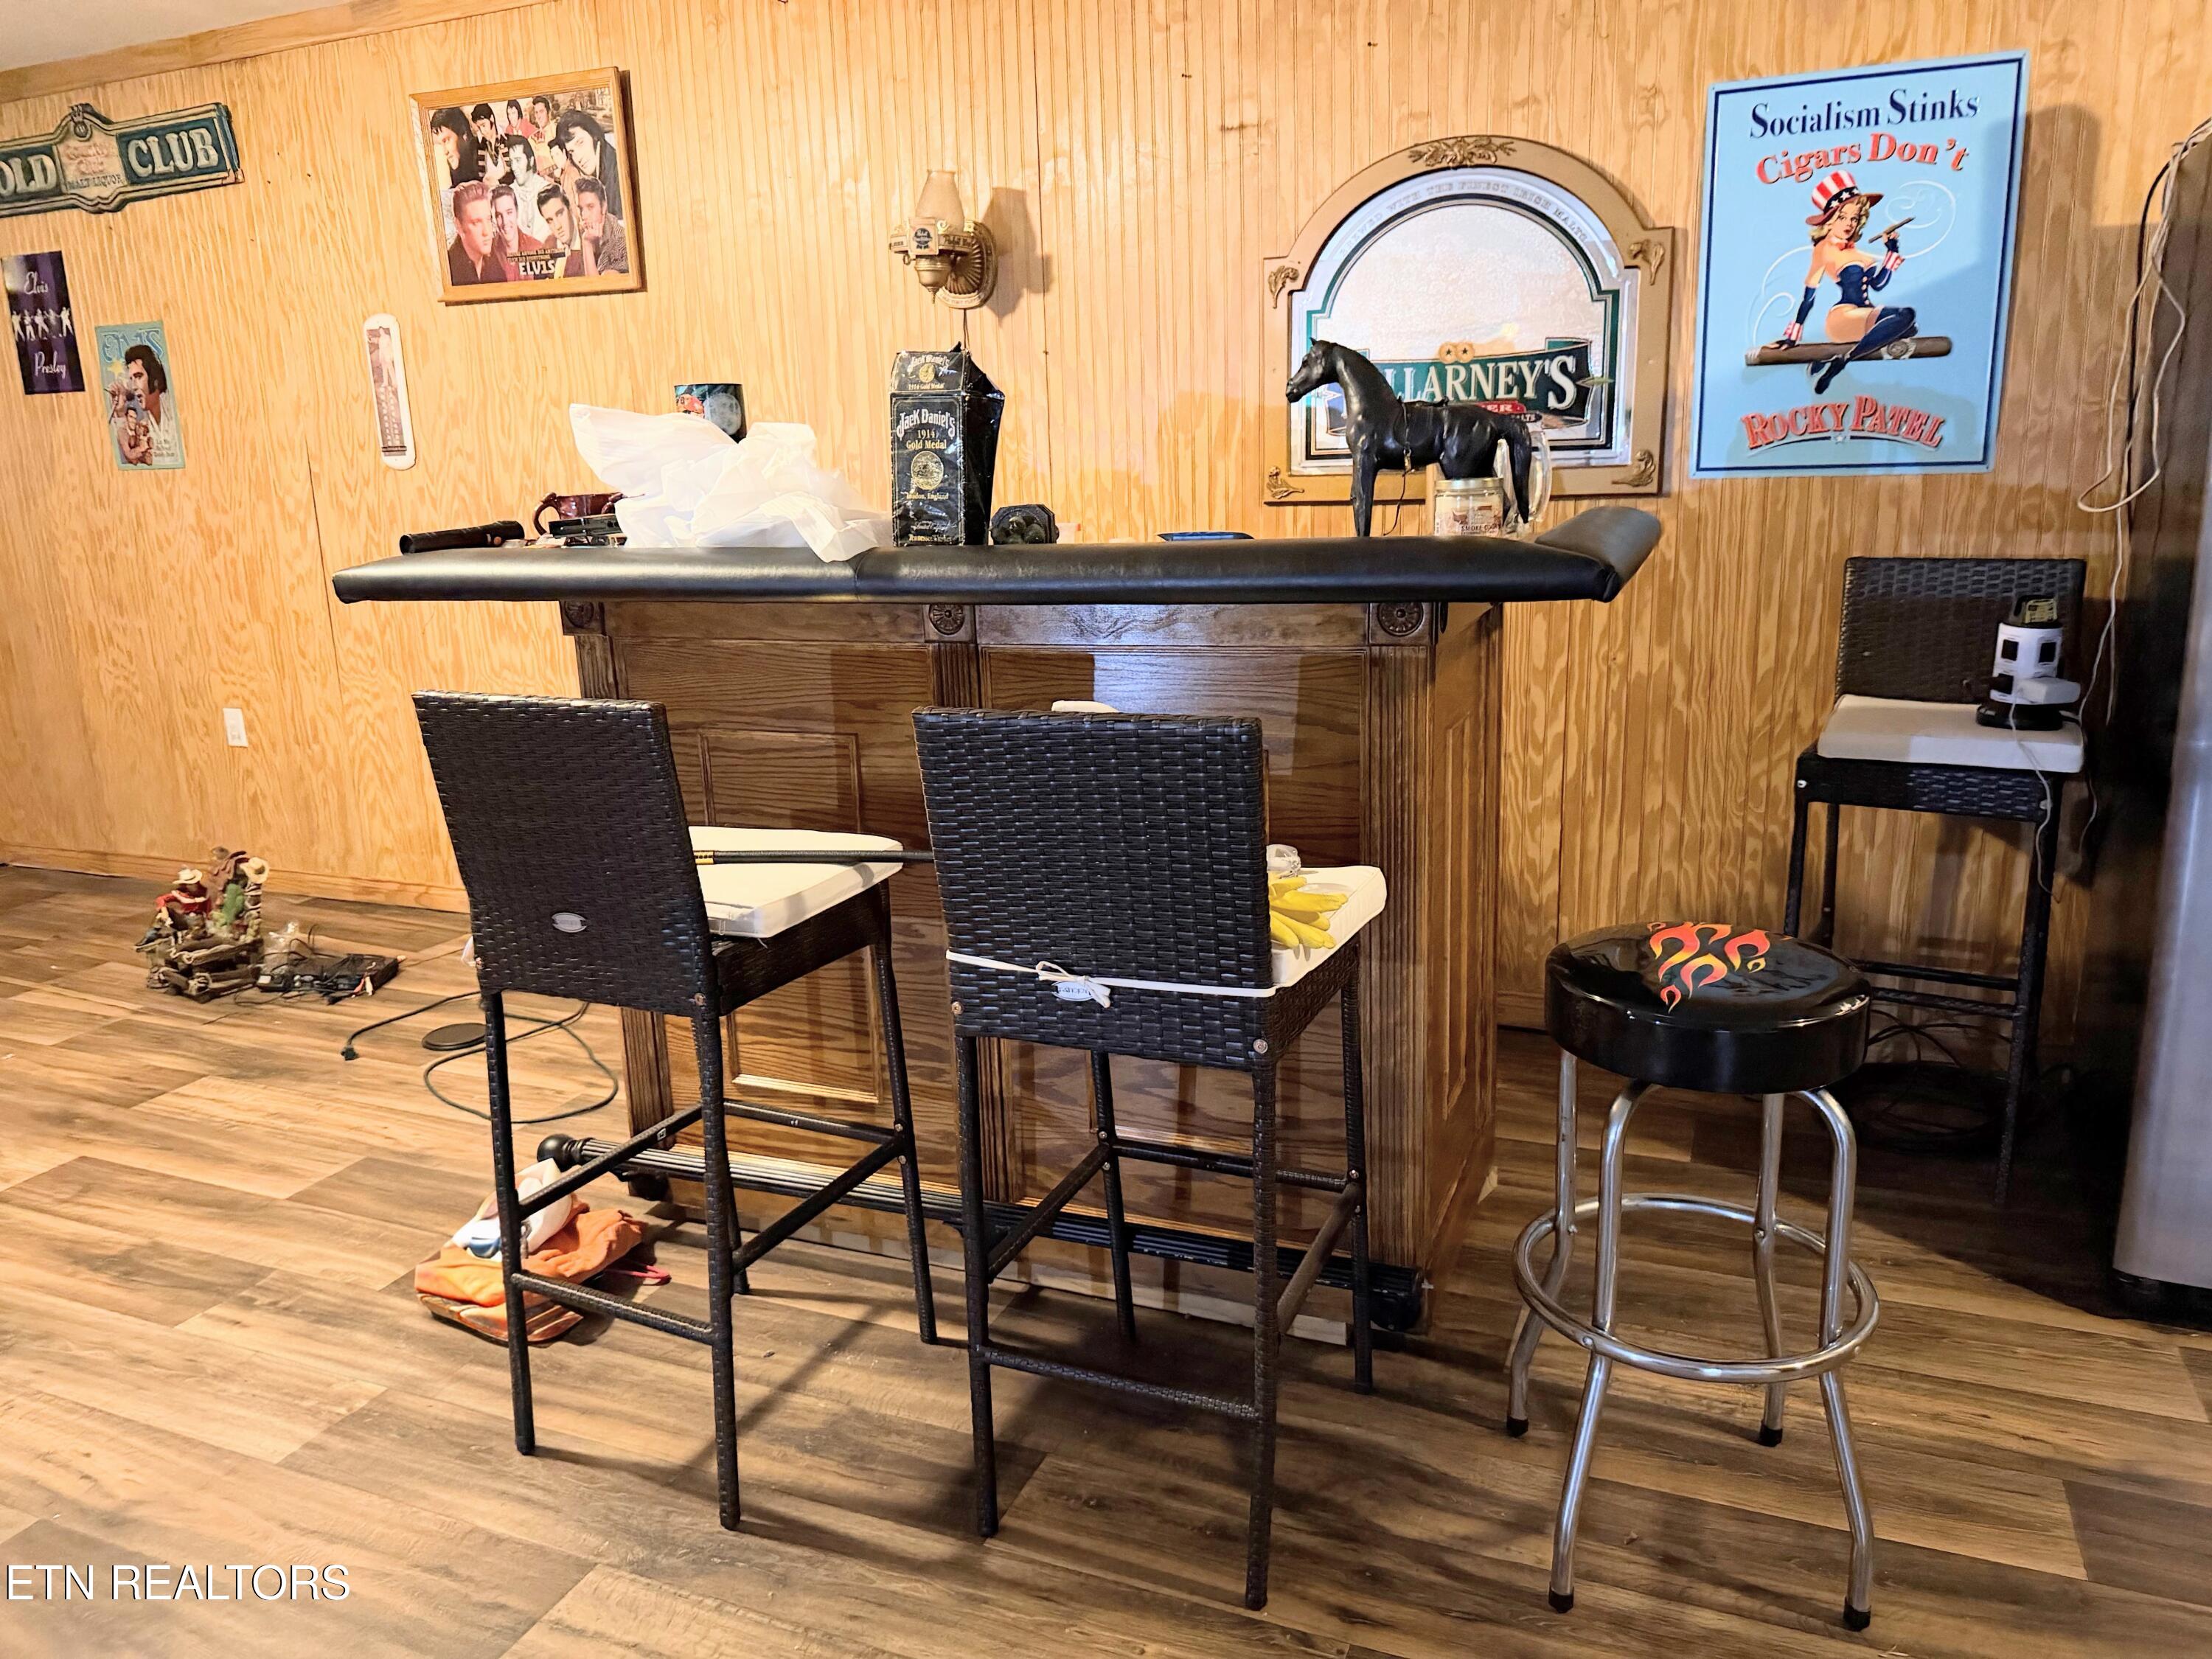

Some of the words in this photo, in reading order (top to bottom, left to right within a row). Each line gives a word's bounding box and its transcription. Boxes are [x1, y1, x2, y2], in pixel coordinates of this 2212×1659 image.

[1750, 100, 1881, 139] Socialism
[1887, 88, 1981, 125] Stinks
[128, 128, 219, 178] CLUB
[1756, 143, 1862, 184] Cigars
[1867, 131, 1970, 172] Don't
[24, 271, 49, 295] Elvis
[35, 350, 66, 380] Presley
[921, 408, 956, 440] Daniel's
[1740, 403, 1849, 450] ROCKY
[1849, 394, 1945, 448] PATEL
[906, 439, 922, 451] Gold
[925, 439, 947, 450] Medal
